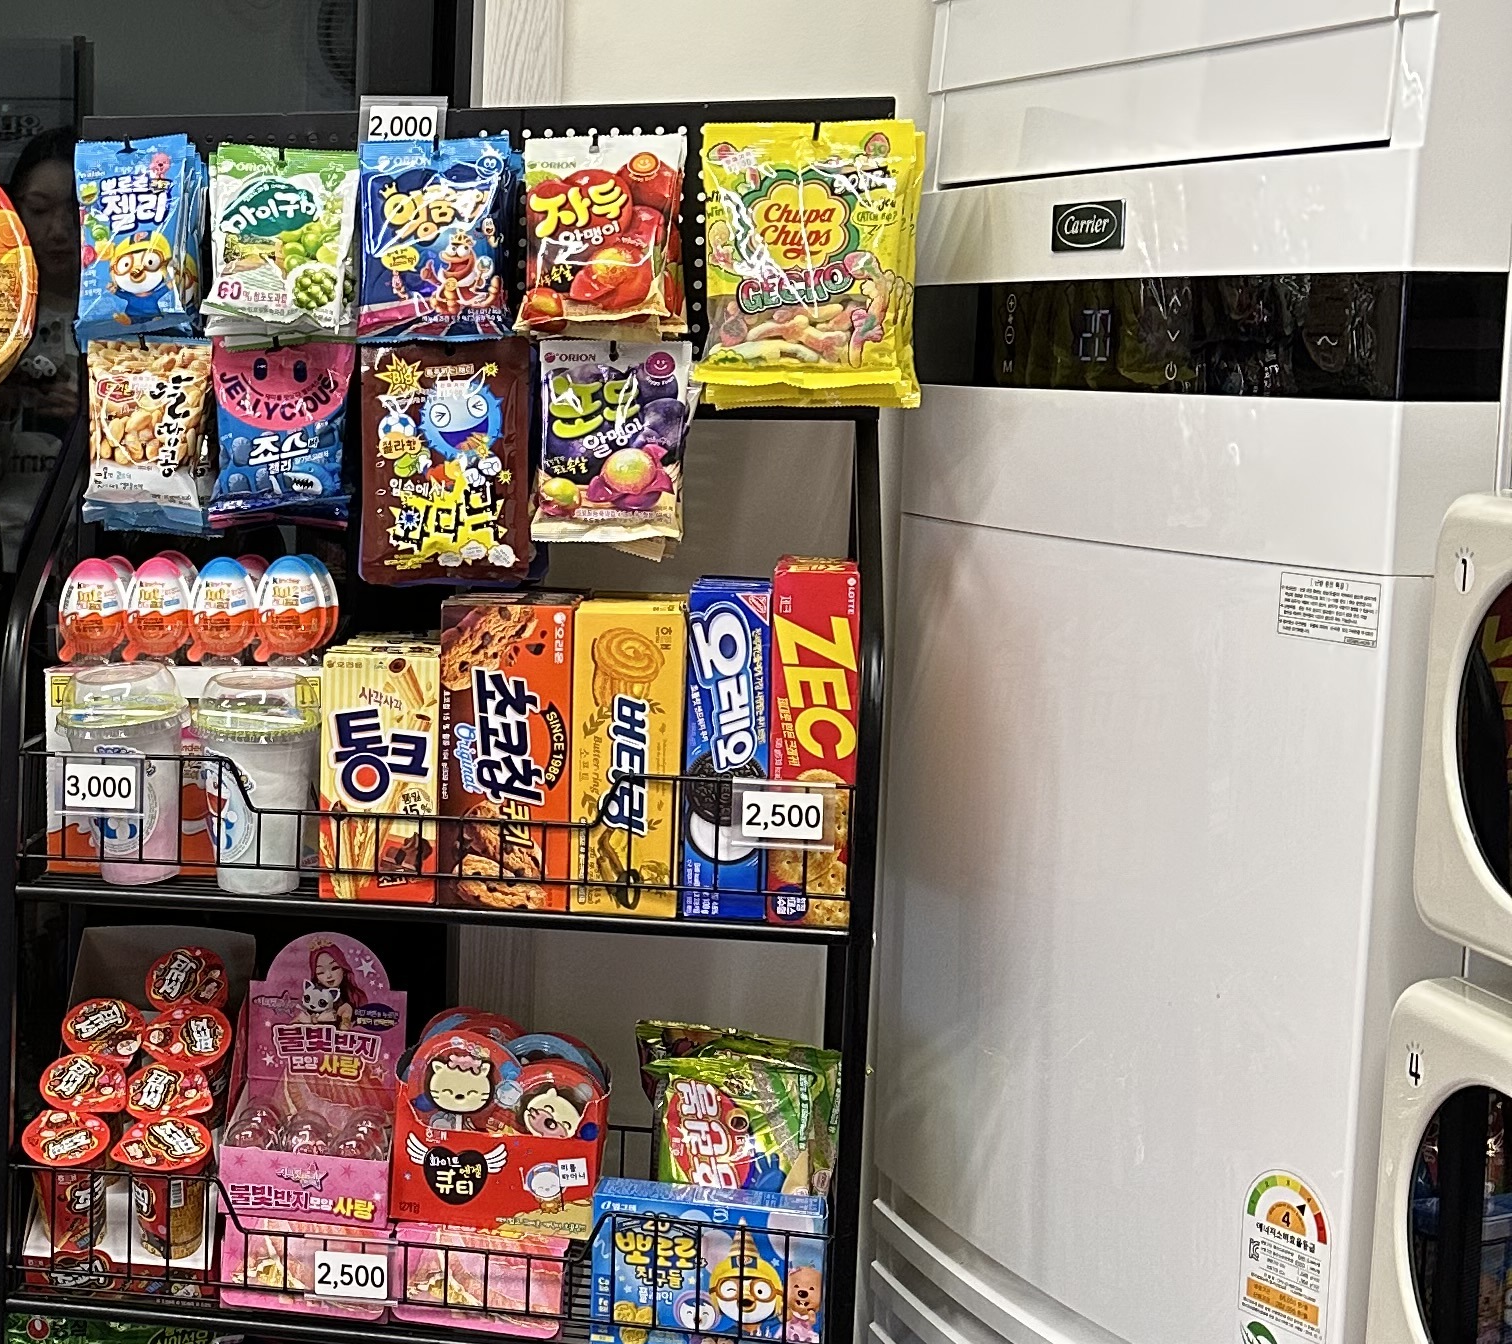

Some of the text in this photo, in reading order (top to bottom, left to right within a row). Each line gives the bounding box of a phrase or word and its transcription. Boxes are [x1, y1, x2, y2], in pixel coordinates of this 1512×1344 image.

[370, 116, 432, 137] 2,000
[236, 164, 272, 173] ORION
[540, 161, 577, 169] ORION
[101, 192, 168, 232] 젤리
[530, 179, 628, 238] 자두
[764, 203, 836, 225] Chupa
[761, 225, 832, 249] Chups
[1064, 214, 1110, 236] Carrier
[217, 281, 242, 300] 60
[740, 262, 851, 312] GECKO
[559, 353, 595, 362] ORION
[219, 370, 340, 422] JELLYCIOUS
[550, 380, 640, 440] 포도
[249, 432, 308, 466] 죠스
[1462, 558, 1468, 592] 1
[846, 587, 855, 615] LOTTE
[554, 627, 565, 665] 오리온
[358, 687, 403, 710] 사각사각
[692, 612, 754, 770] 오레오
[773, 613, 858, 761] ZEC
[475, 669, 543, 804] 초코칩
[546, 711, 565, 782] SINCE 1986
[336, 710, 429, 803] 통크
[455, 724, 481, 793] Original
[605, 697, 646, 835] 버터링
[67, 776, 131, 800] 3,000
[503, 800, 534, 848] 쿠키
[745, 803, 821, 831] 2,500
[277, 1027, 377, 1058] 불빛반지
[1408, 1052, 1421, 1086] 4
[229, 1184, 310, 1211] 불빛반지
[436, 1171, 474, 1196] 큐티
[1282, 1212, 1291, 1227] 4
[615, 1232, 697, 1268] 뽀로로
[317, 1263, 385, 1288] 2,500
[636, 1267, 684, 1289] 친구들
